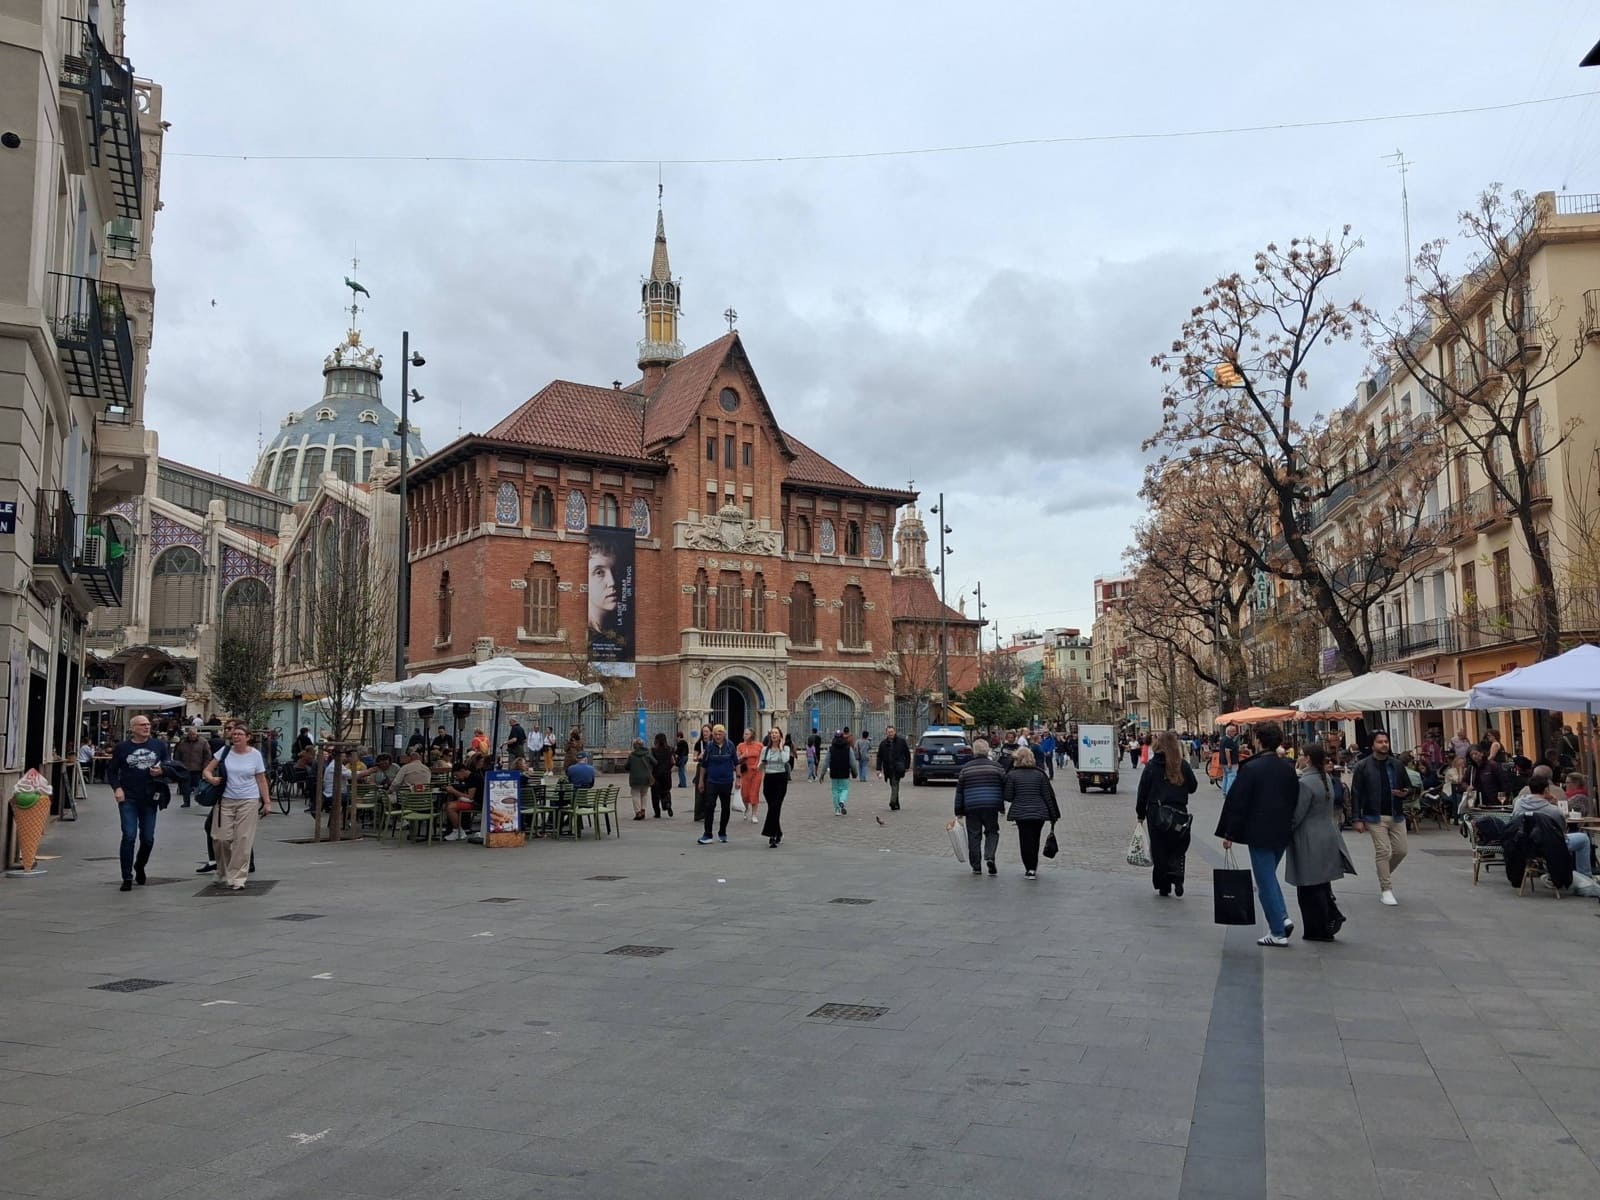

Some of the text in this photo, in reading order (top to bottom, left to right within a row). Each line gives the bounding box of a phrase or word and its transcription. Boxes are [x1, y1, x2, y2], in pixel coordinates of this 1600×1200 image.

[1257, 569, 1267, 609] ACIA
[617, 618, 623, 626] LA
[1384, 699, 1434, 709] PANARIA
